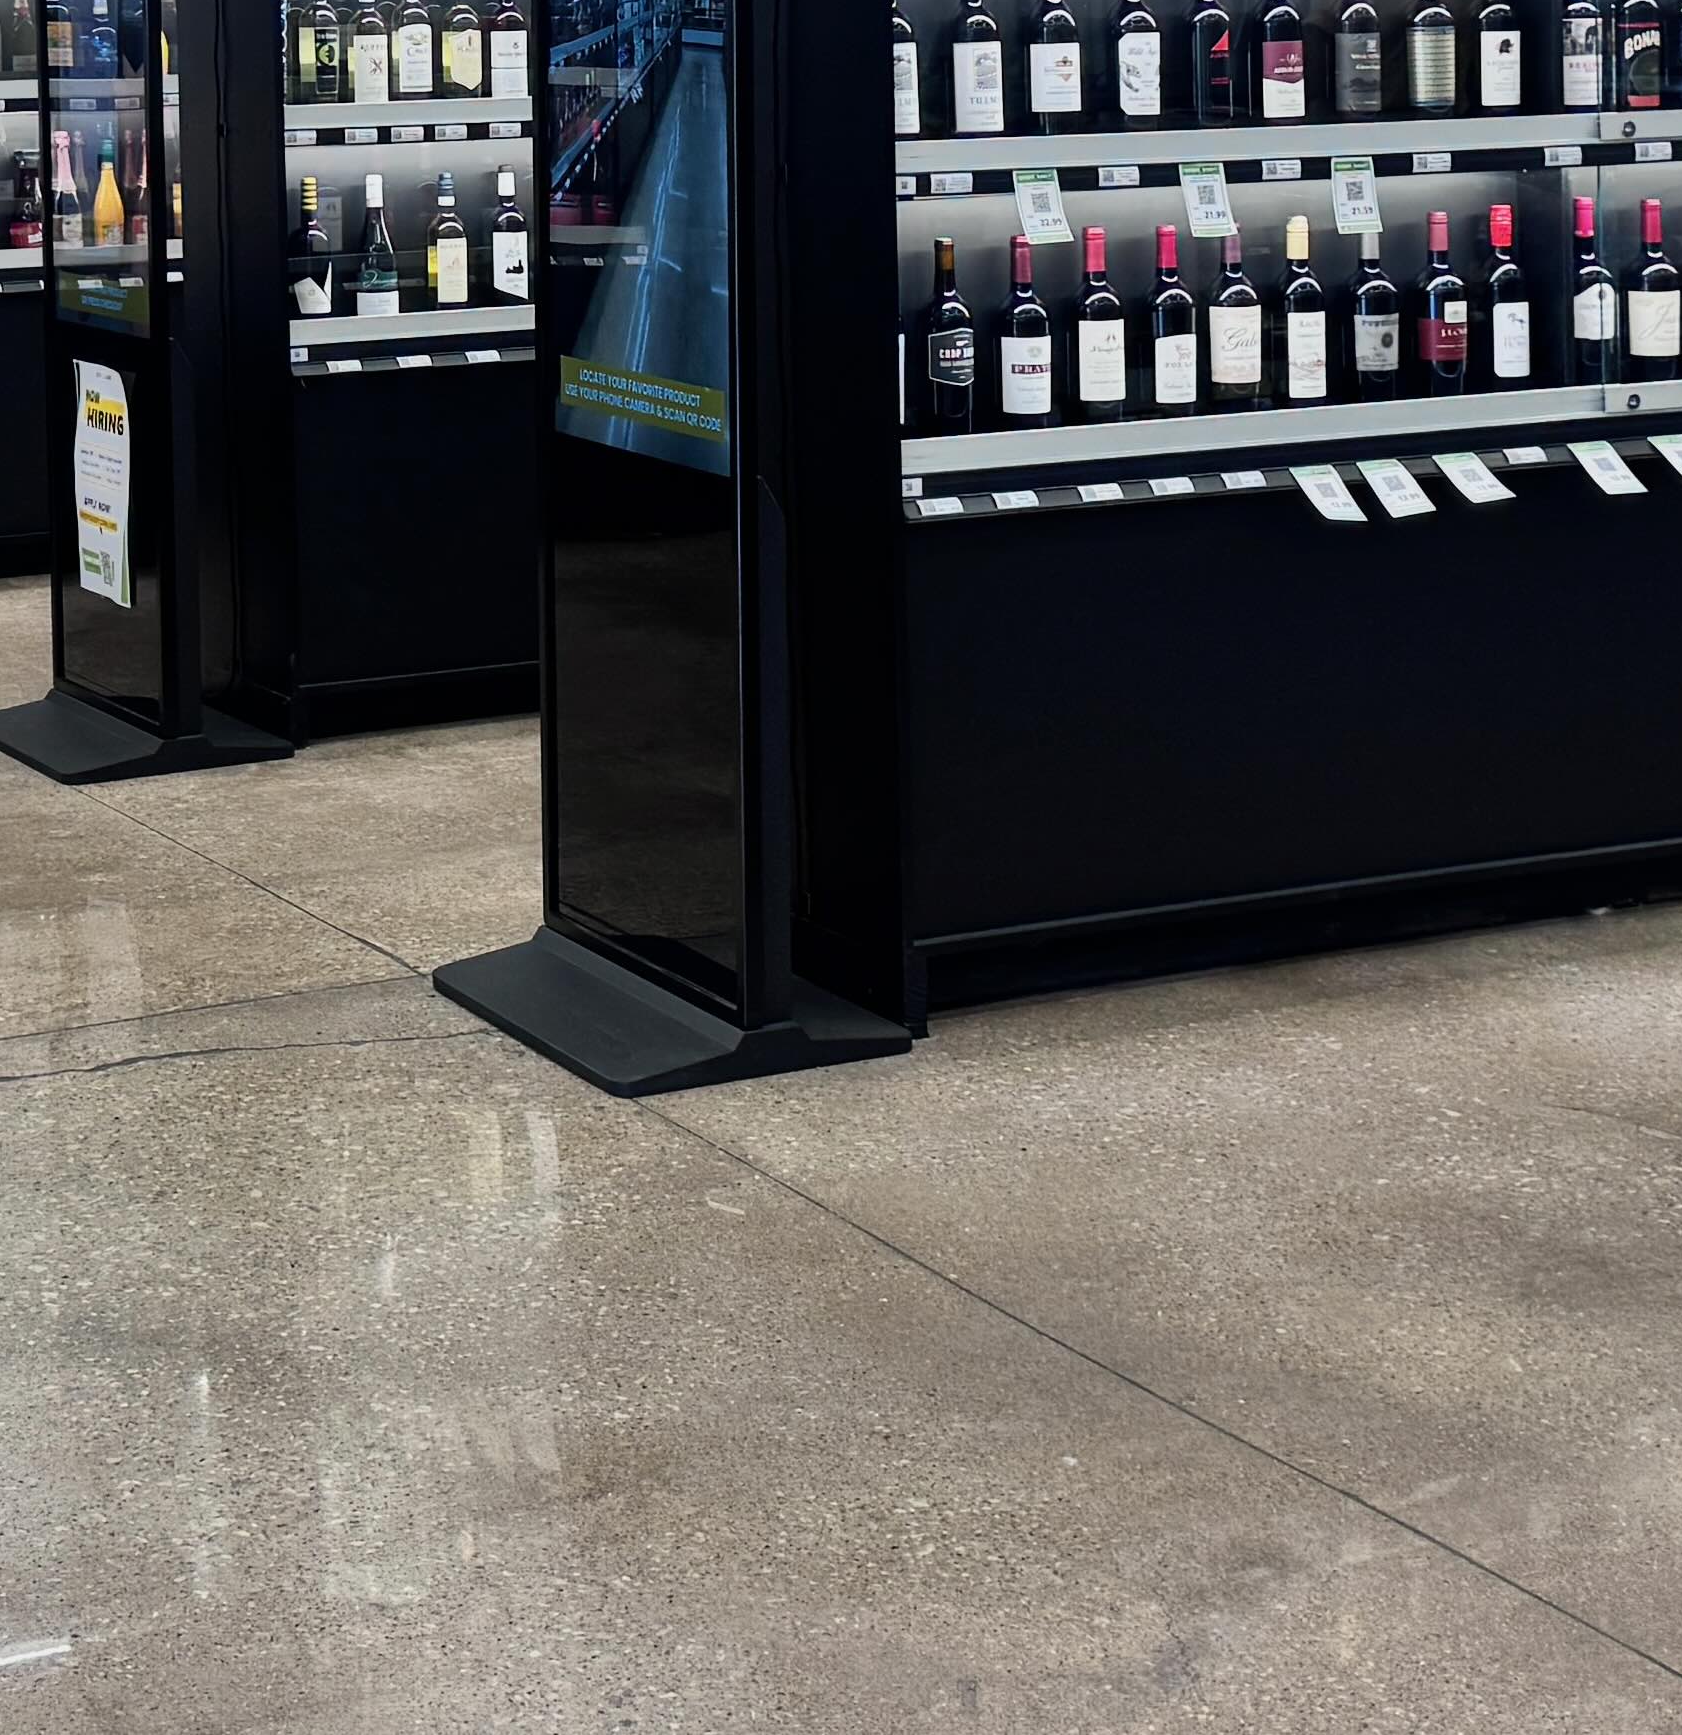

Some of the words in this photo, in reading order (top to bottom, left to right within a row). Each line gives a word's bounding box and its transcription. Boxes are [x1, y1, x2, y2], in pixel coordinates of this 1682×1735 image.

[579, 369, 607, 384] LOCATE
[607, 375, 627, 389] YOUR
[628, 379, 663, 400] FAVORITE
[663, 388, 701, 407] PRODUCT
[87, 407, 124, 435] HIRING
[565, 383, 578, 396] USE
[579, 386, 599, 401] YOUR
[599, 390, 623, 408] PHONE
[624, 397, 655, 416] CAMERA
[663, 407, 686, 423] SCAN
[687, 414, 699, 428] QR
[699, 415, 722, 432] CODE
